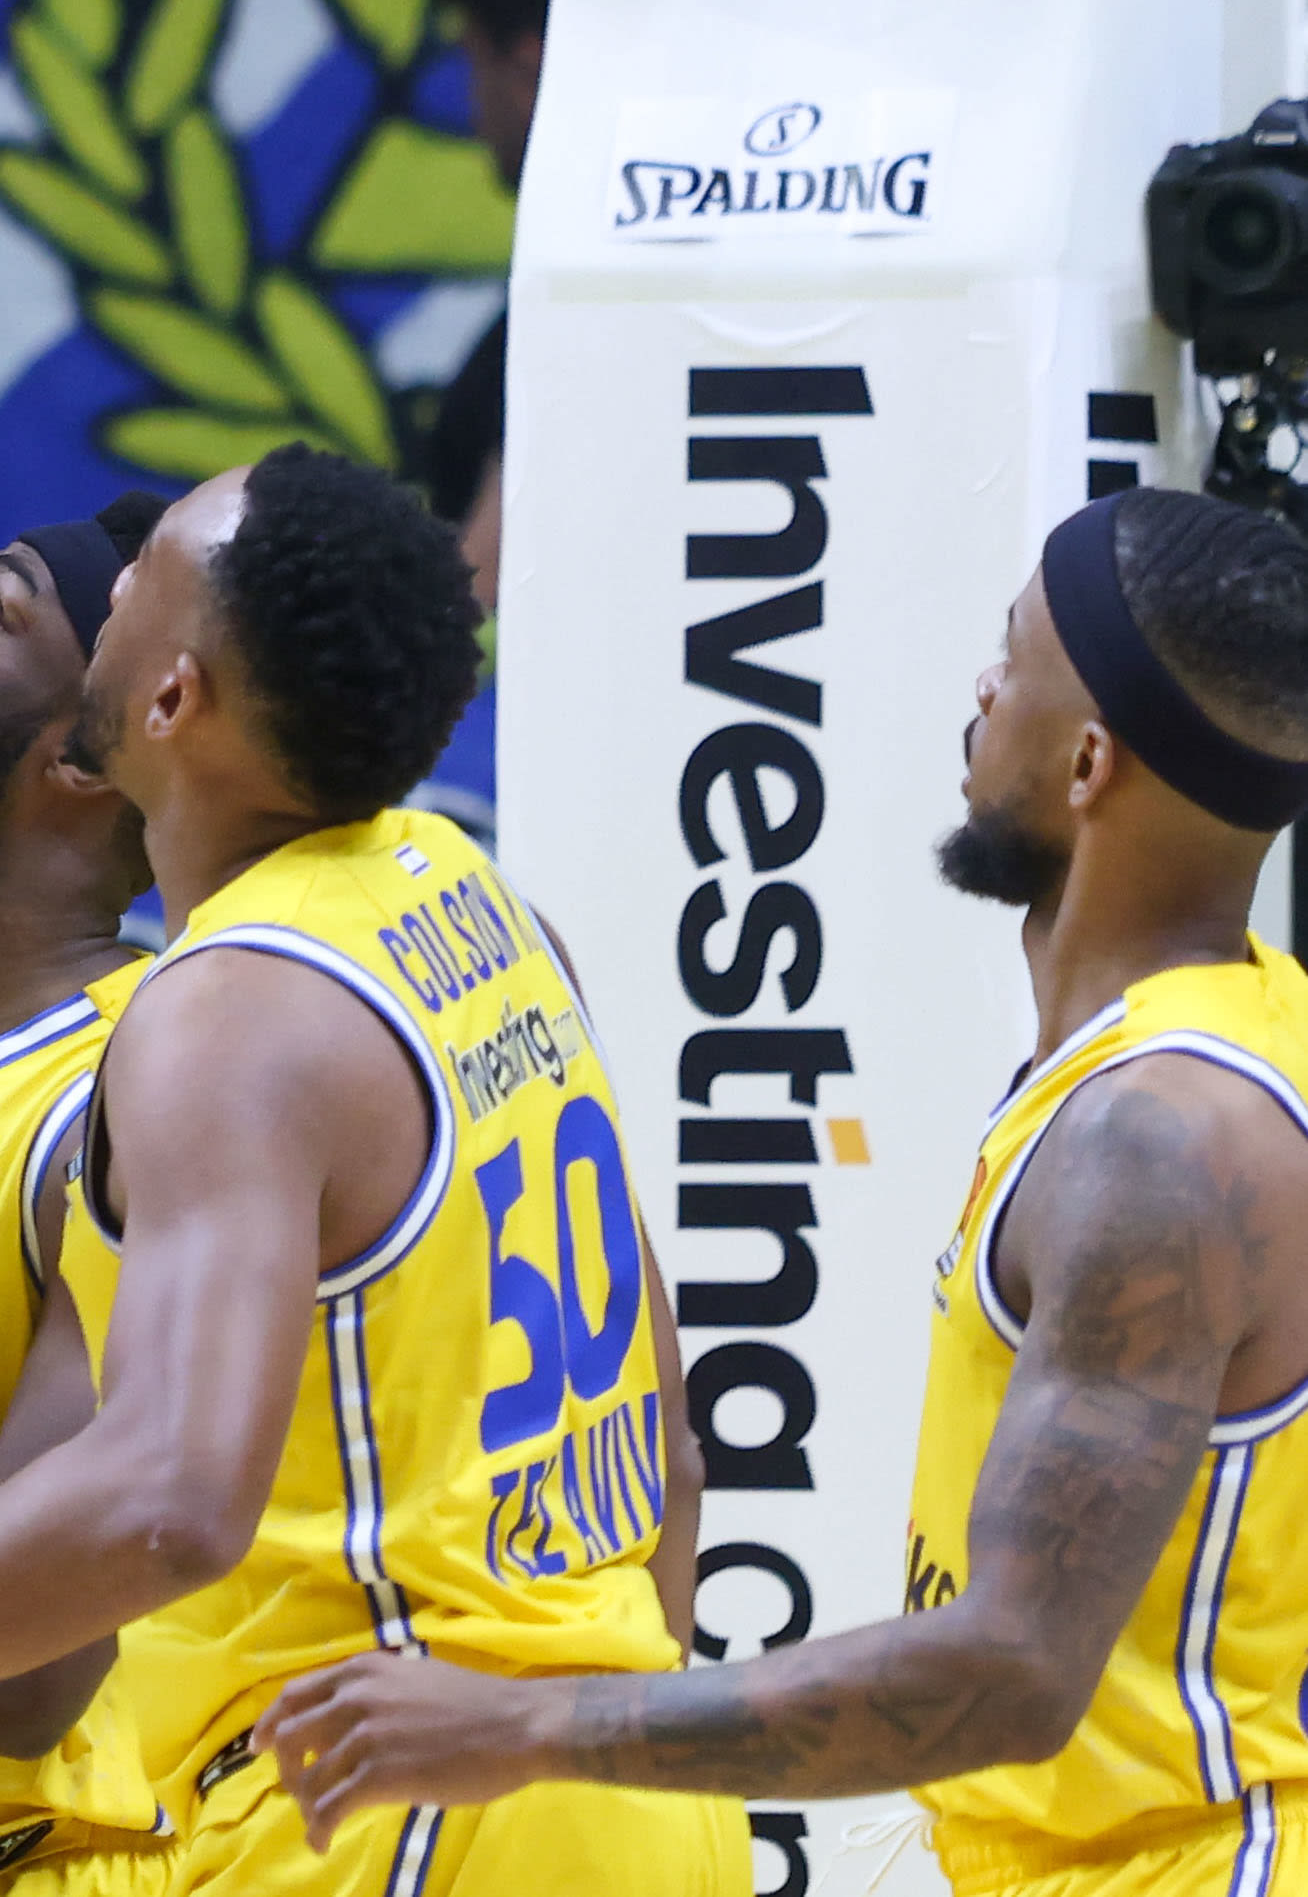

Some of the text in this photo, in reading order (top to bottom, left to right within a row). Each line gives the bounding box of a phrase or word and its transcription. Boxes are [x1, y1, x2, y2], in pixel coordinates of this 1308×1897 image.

[614, 149, 932, 227] SPALDING
[475, 1095, 644, 1456] 50
[561, 1390, 665, 1566] AVIV
